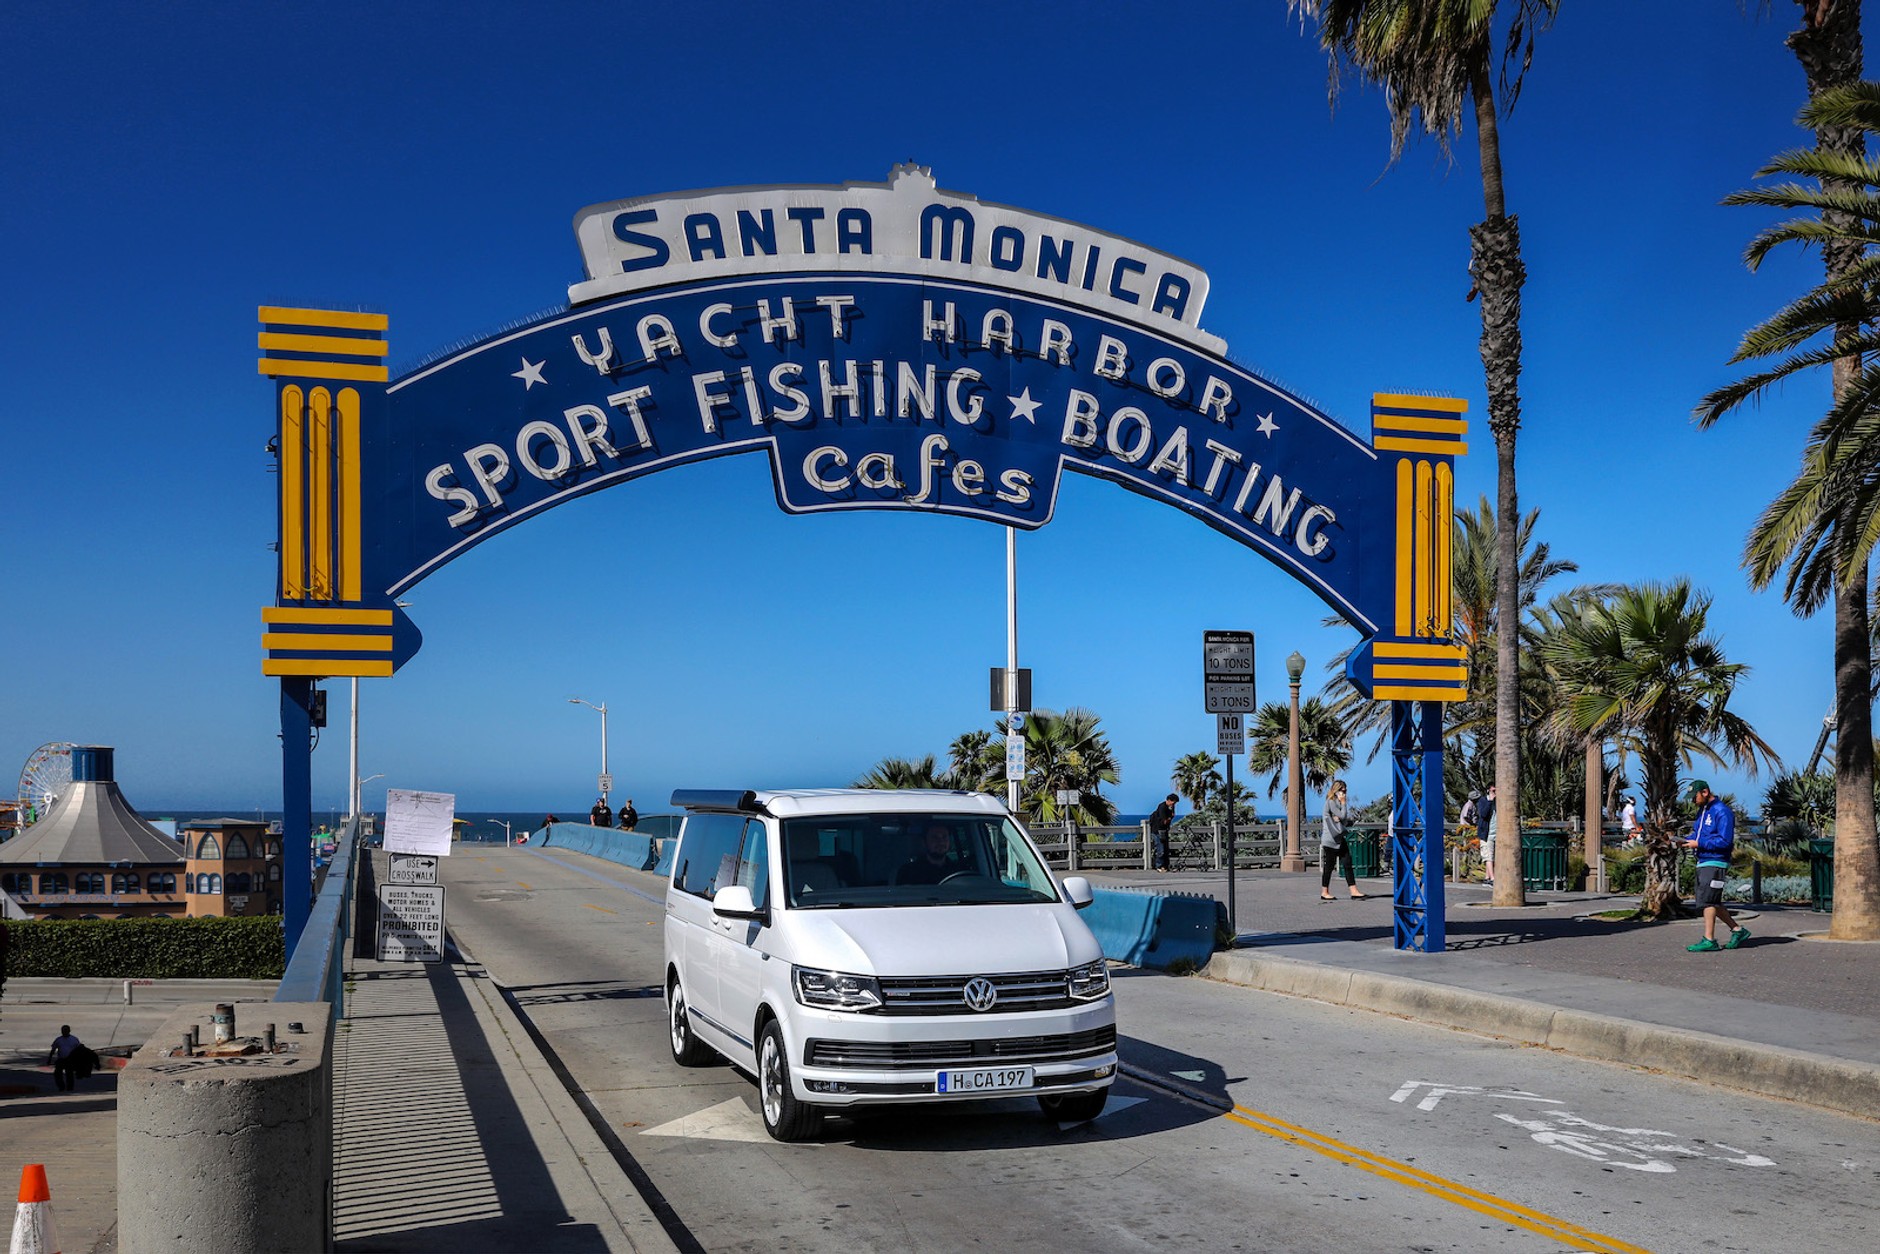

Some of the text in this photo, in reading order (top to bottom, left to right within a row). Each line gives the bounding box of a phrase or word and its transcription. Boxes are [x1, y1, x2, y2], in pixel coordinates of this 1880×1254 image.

[613, 203, 1191, 320] SANTA MONICA
[571, 295, 1233, 423] YACHT HARBOR
[425, 360, 1337, 556] SPORT FISHING BOATING
[1209, 658, 1250, 669] 10 TONS
[1211, 696, 1250, 708] 3 TONS
[1222, 716, 1239, 730] NO
[1220, 732, 1242, 740] BUSES
[406, 859, 421, 869] USE
[391, 870, 434, 881] CROSSWALK
[382, 920, 439, 931] PROHIBITED
[953, 1070, 1026, 1089] H CA 197
